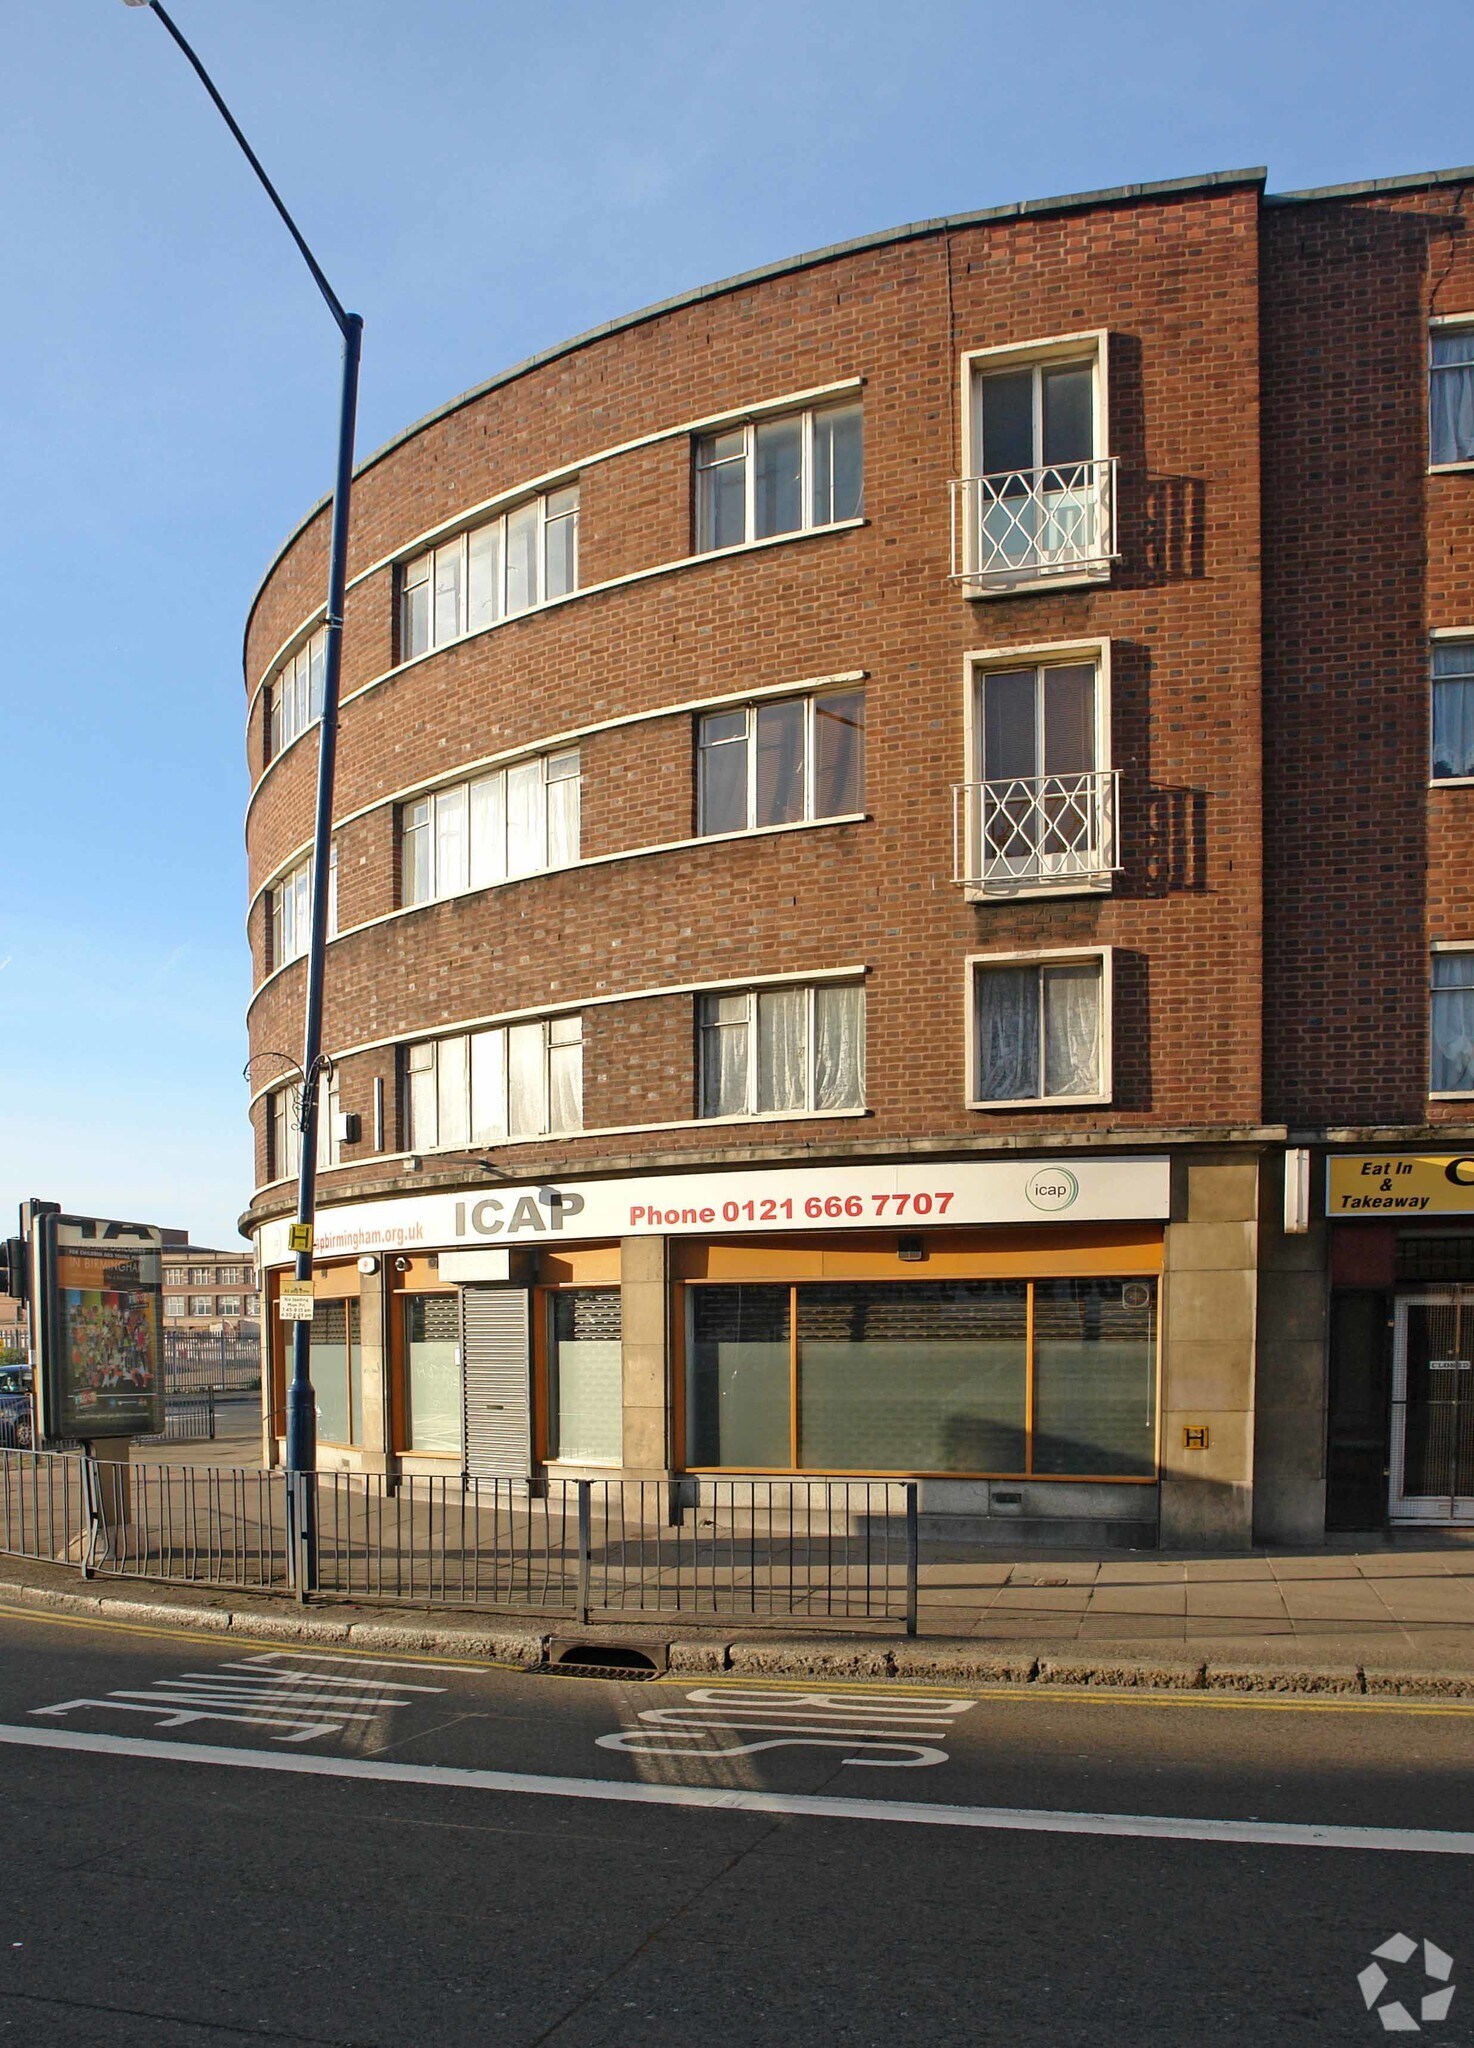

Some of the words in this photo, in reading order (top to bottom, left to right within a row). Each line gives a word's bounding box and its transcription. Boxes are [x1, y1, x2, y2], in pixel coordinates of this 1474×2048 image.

[1361, 1162, 1390, 1175] Eat
[1395, 1162, 1413, 1175] In
[1035, 1183, 1067, 1198] icap
[1380, 1178, 1393, 1192] &
[630, 1205, 716, 1226] Phone
[722, 1197, 793, 1222] 0121
[804, 1195, 863, 1218] 666
[871, 1192, 955, 1216] 7707
[1341, 1195, 1430, 1210] Takeaway
[455, 1192, 585, 1236] ICAP
[291, 1226, 309, 1248] H
[315, 1221, 423, 1254] apbirmingham.org.uk
[70, 1256, 80, 1267] IN
[1186, 1428, 1204, 1447] H
[26, 1651, 490, 1742] LANE
[595, 1688, 979, 1767] BUS
